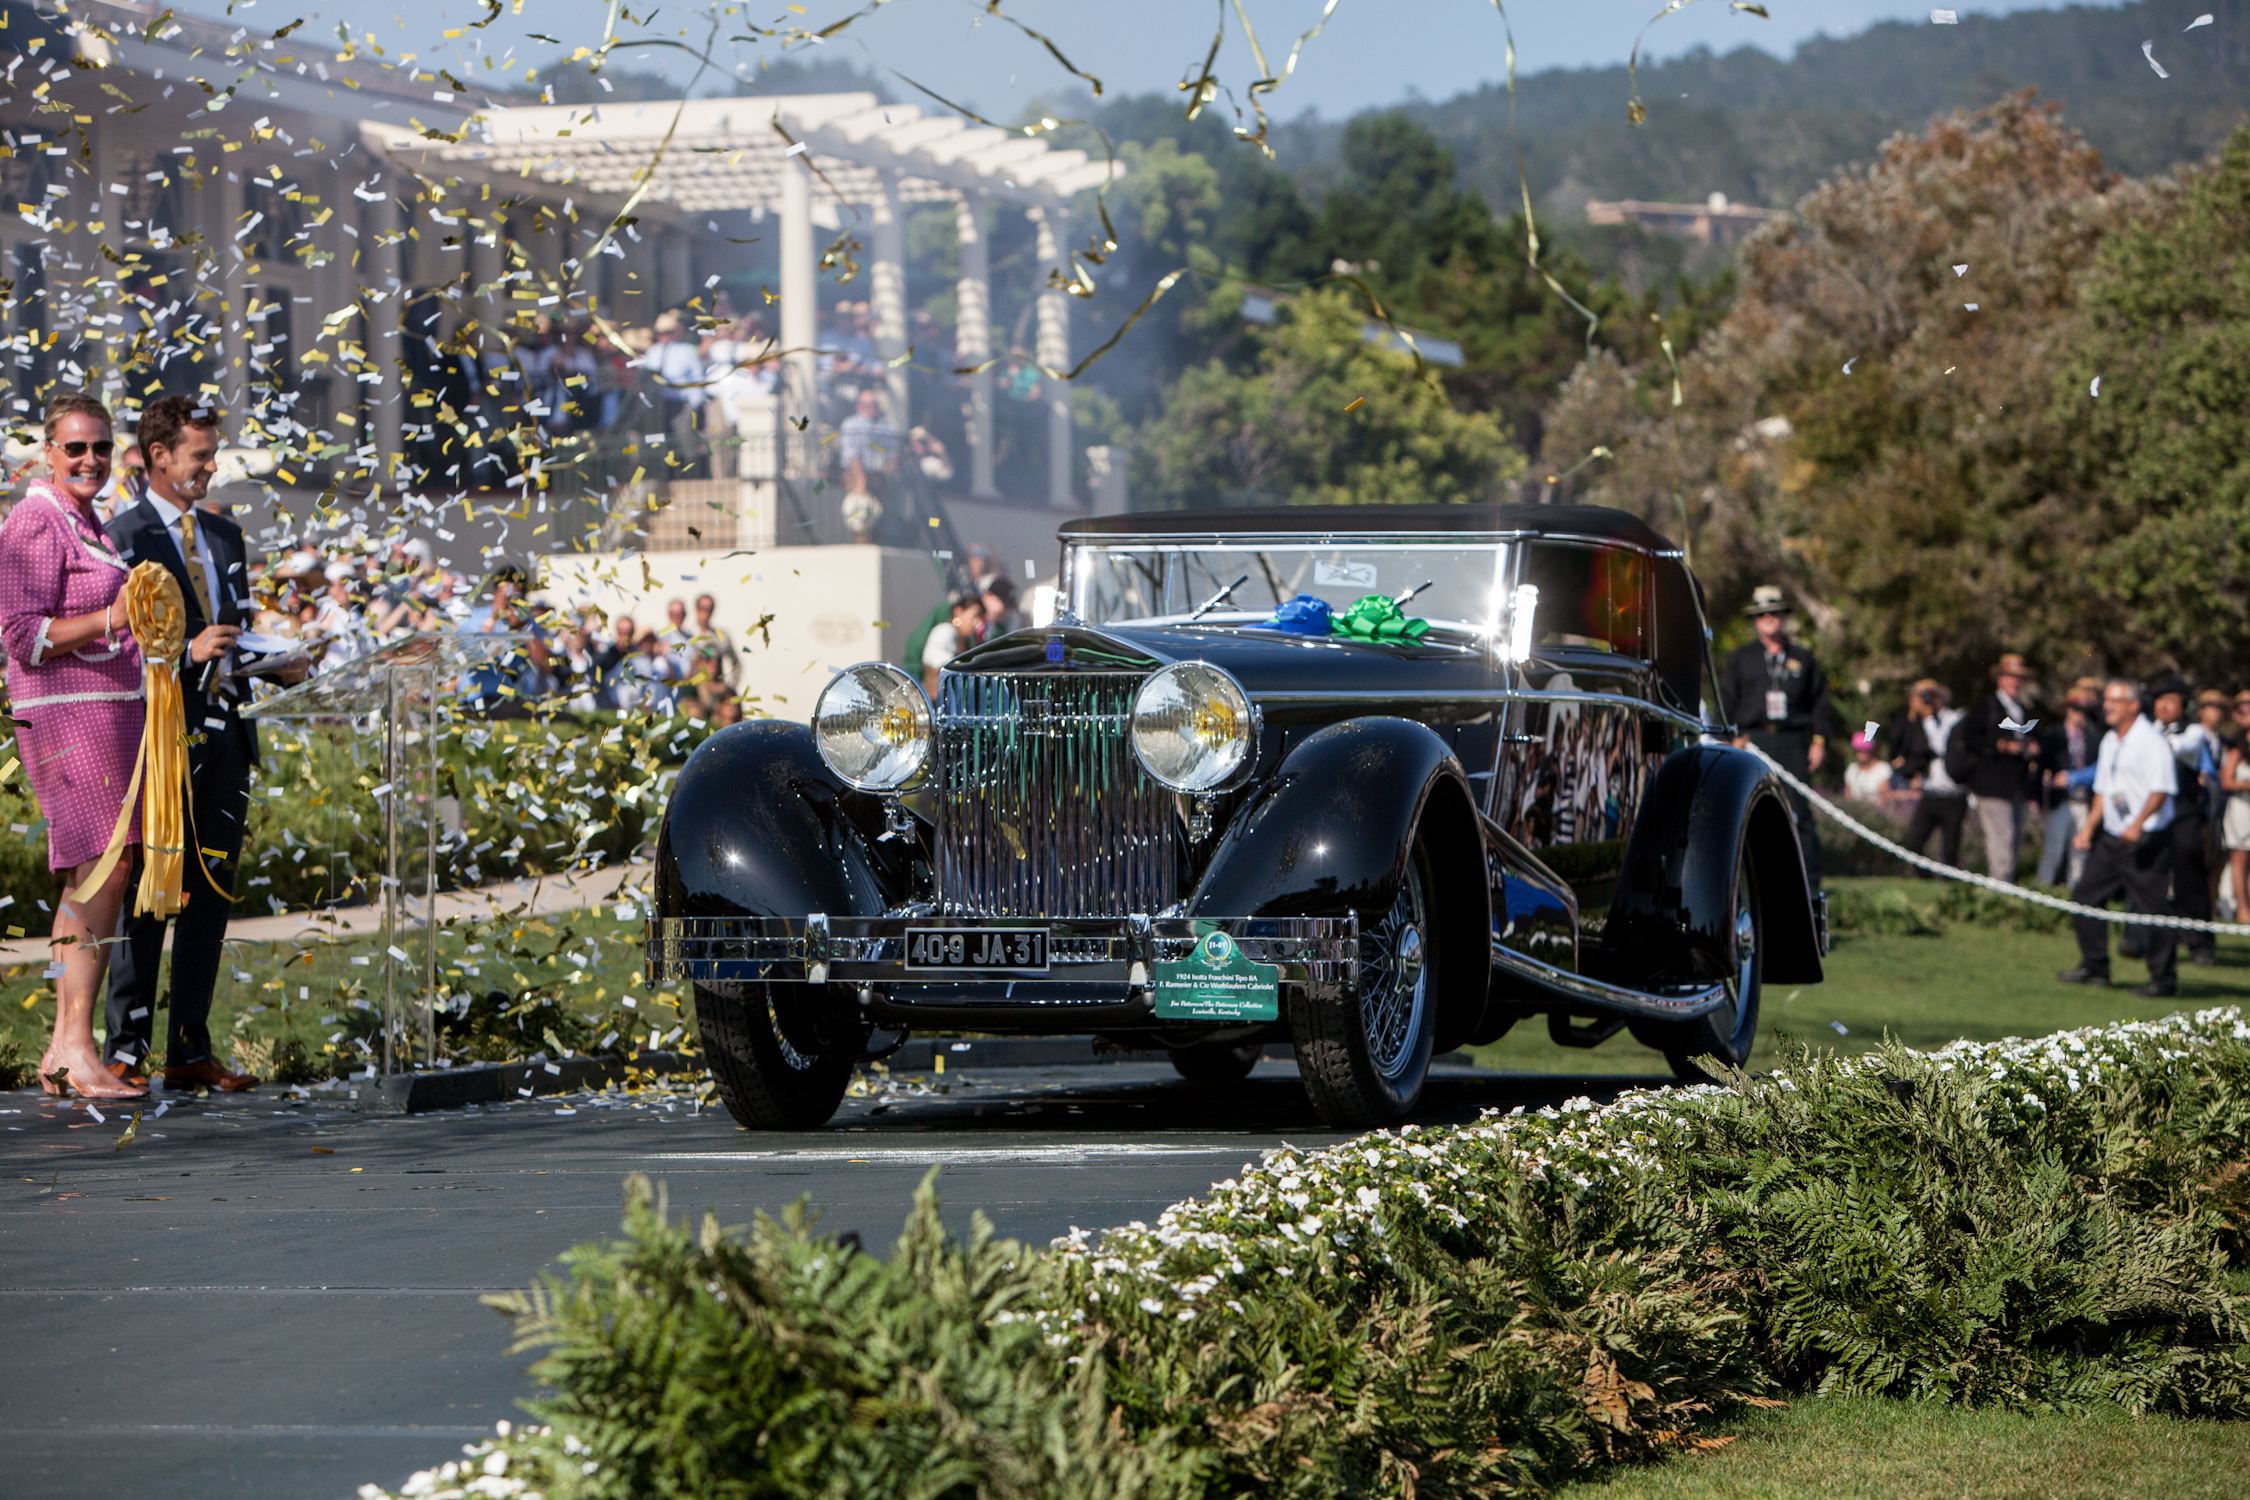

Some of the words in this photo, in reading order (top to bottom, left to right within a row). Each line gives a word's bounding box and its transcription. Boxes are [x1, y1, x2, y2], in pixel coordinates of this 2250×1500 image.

[911, 934, 965, 964] 409
[972, 934, 1007, 964] JA
[1014, 934, 1042, 964] 31
[1209, 941, 1225, 949] J1-01
[1176, 973, 1191, 981] 1924
[1208, 974, 1234, 982] Fraschini
[1235, 974, 1247, 983] Tipo
[1247, 982, 1275, 990] Cabriolet
[1239, 1001, 1263, 1009] Collection
[1217, 1008, 1241, 1016] Kentucky
